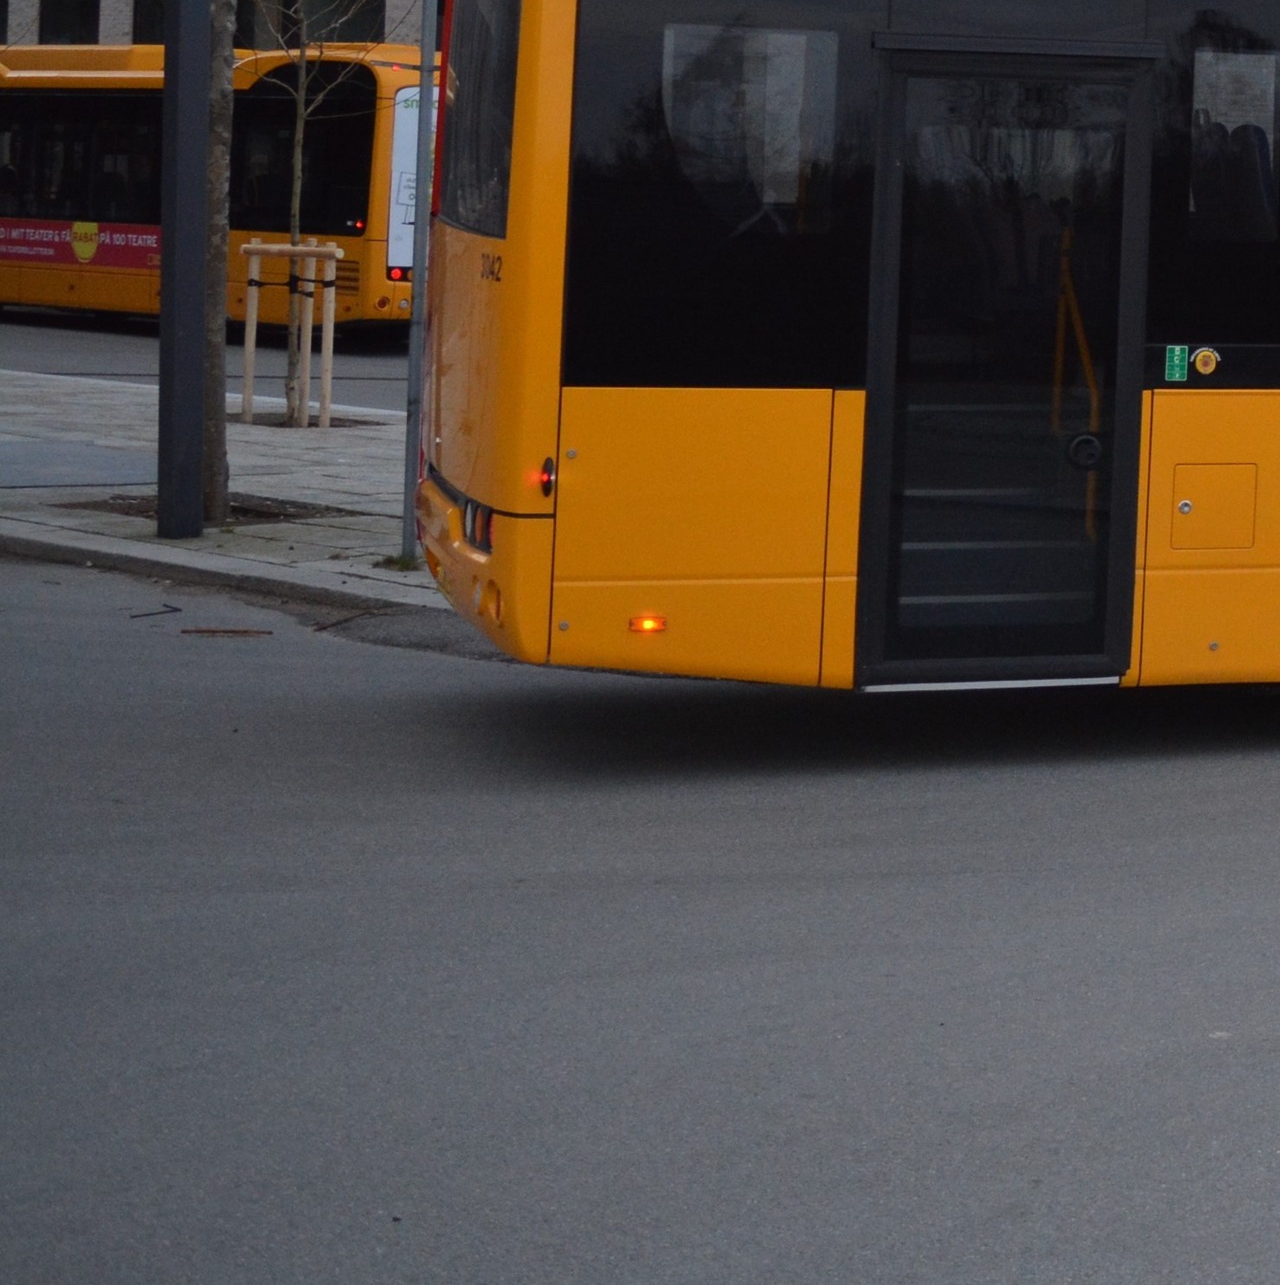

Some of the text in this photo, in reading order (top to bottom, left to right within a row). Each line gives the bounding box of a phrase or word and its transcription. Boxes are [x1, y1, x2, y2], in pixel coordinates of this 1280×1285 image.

[25, 228, 54, 241] TEATER
[73, 231, 98, 243] RABAT
[99, 230, 111, 244] PÅ
[112, 233, 126, 246] 100
[127, 234, 158, 247] TEATRE
